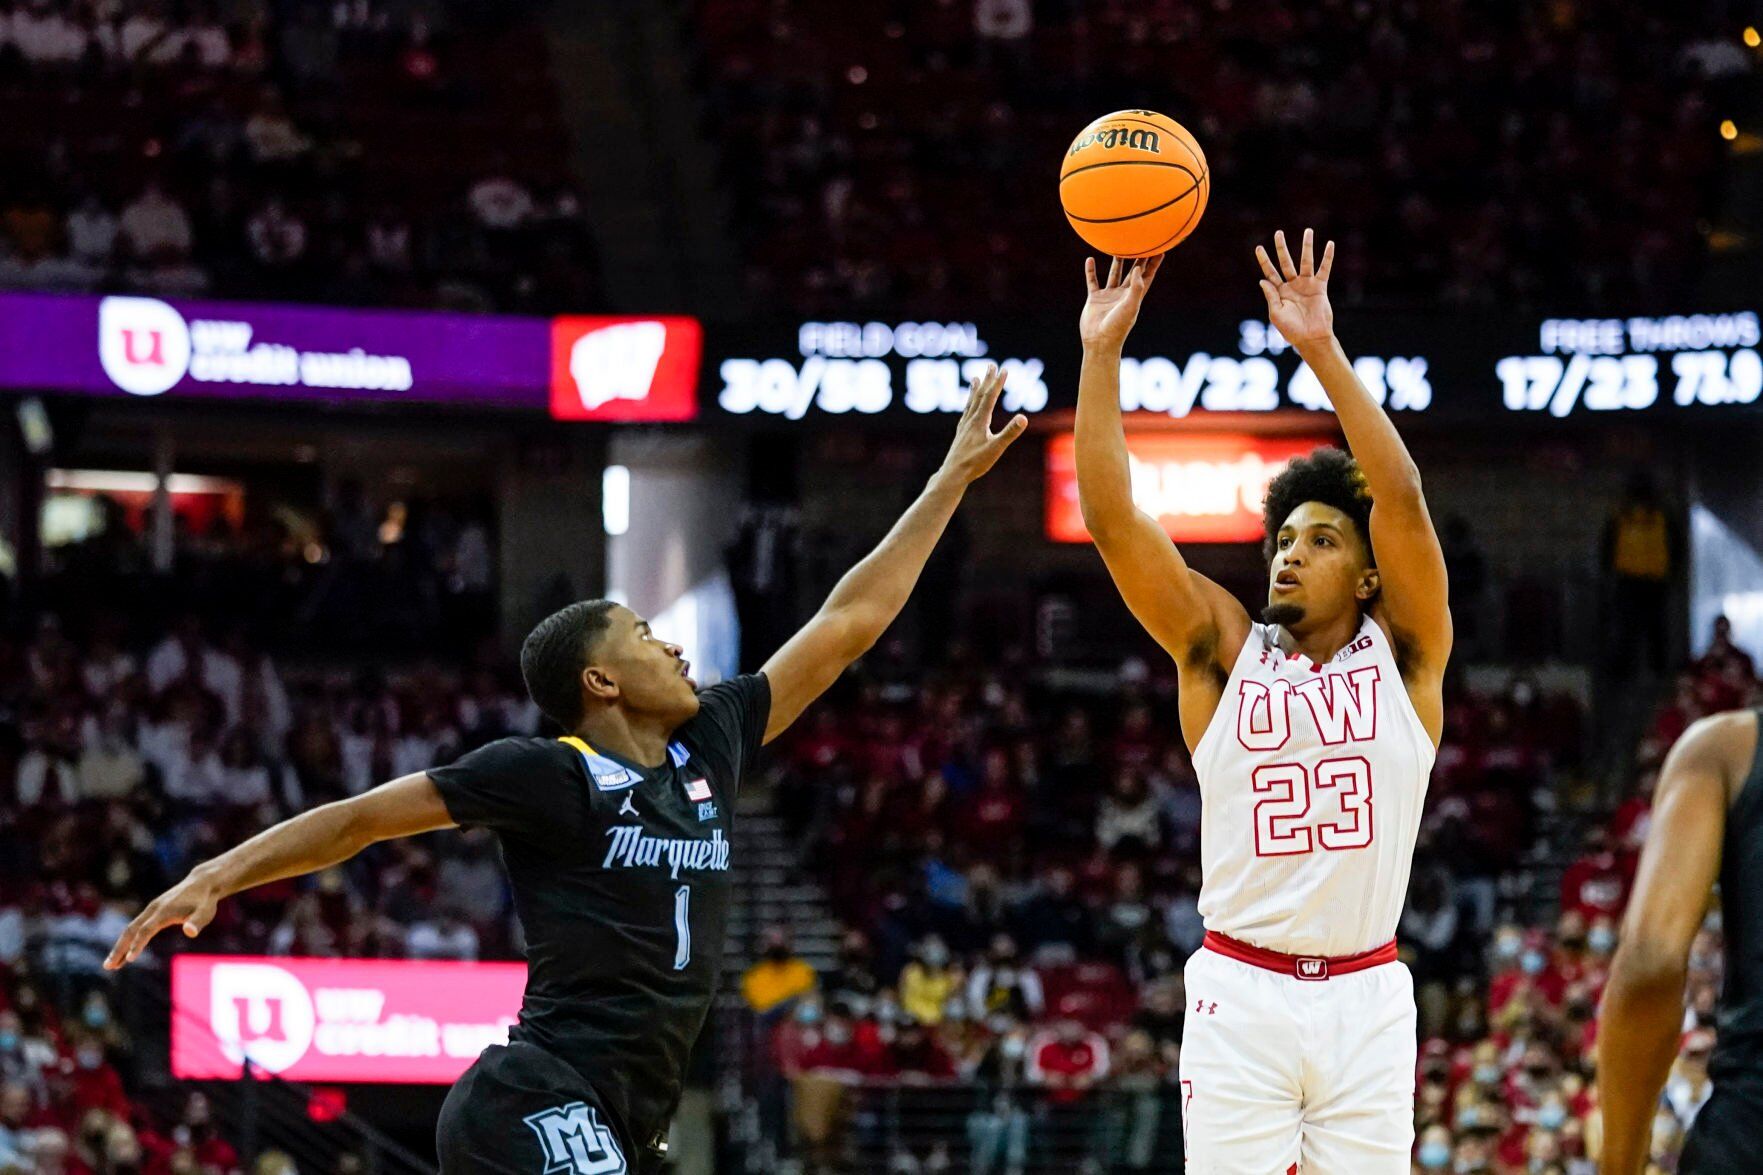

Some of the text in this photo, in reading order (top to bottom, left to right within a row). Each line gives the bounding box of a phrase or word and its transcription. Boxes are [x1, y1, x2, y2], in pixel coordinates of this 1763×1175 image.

[1070, 128, 1159, 156] Wilson
[1238, 666, 1380, 751] UW
[1251, 756, 1374, 857] 23
[603, 826, 728, 879] Marquette
[673, 885, 690, 971] 1
[1301, 960, 1322, 975] W
[523, 1101, 627, 1175] MU
